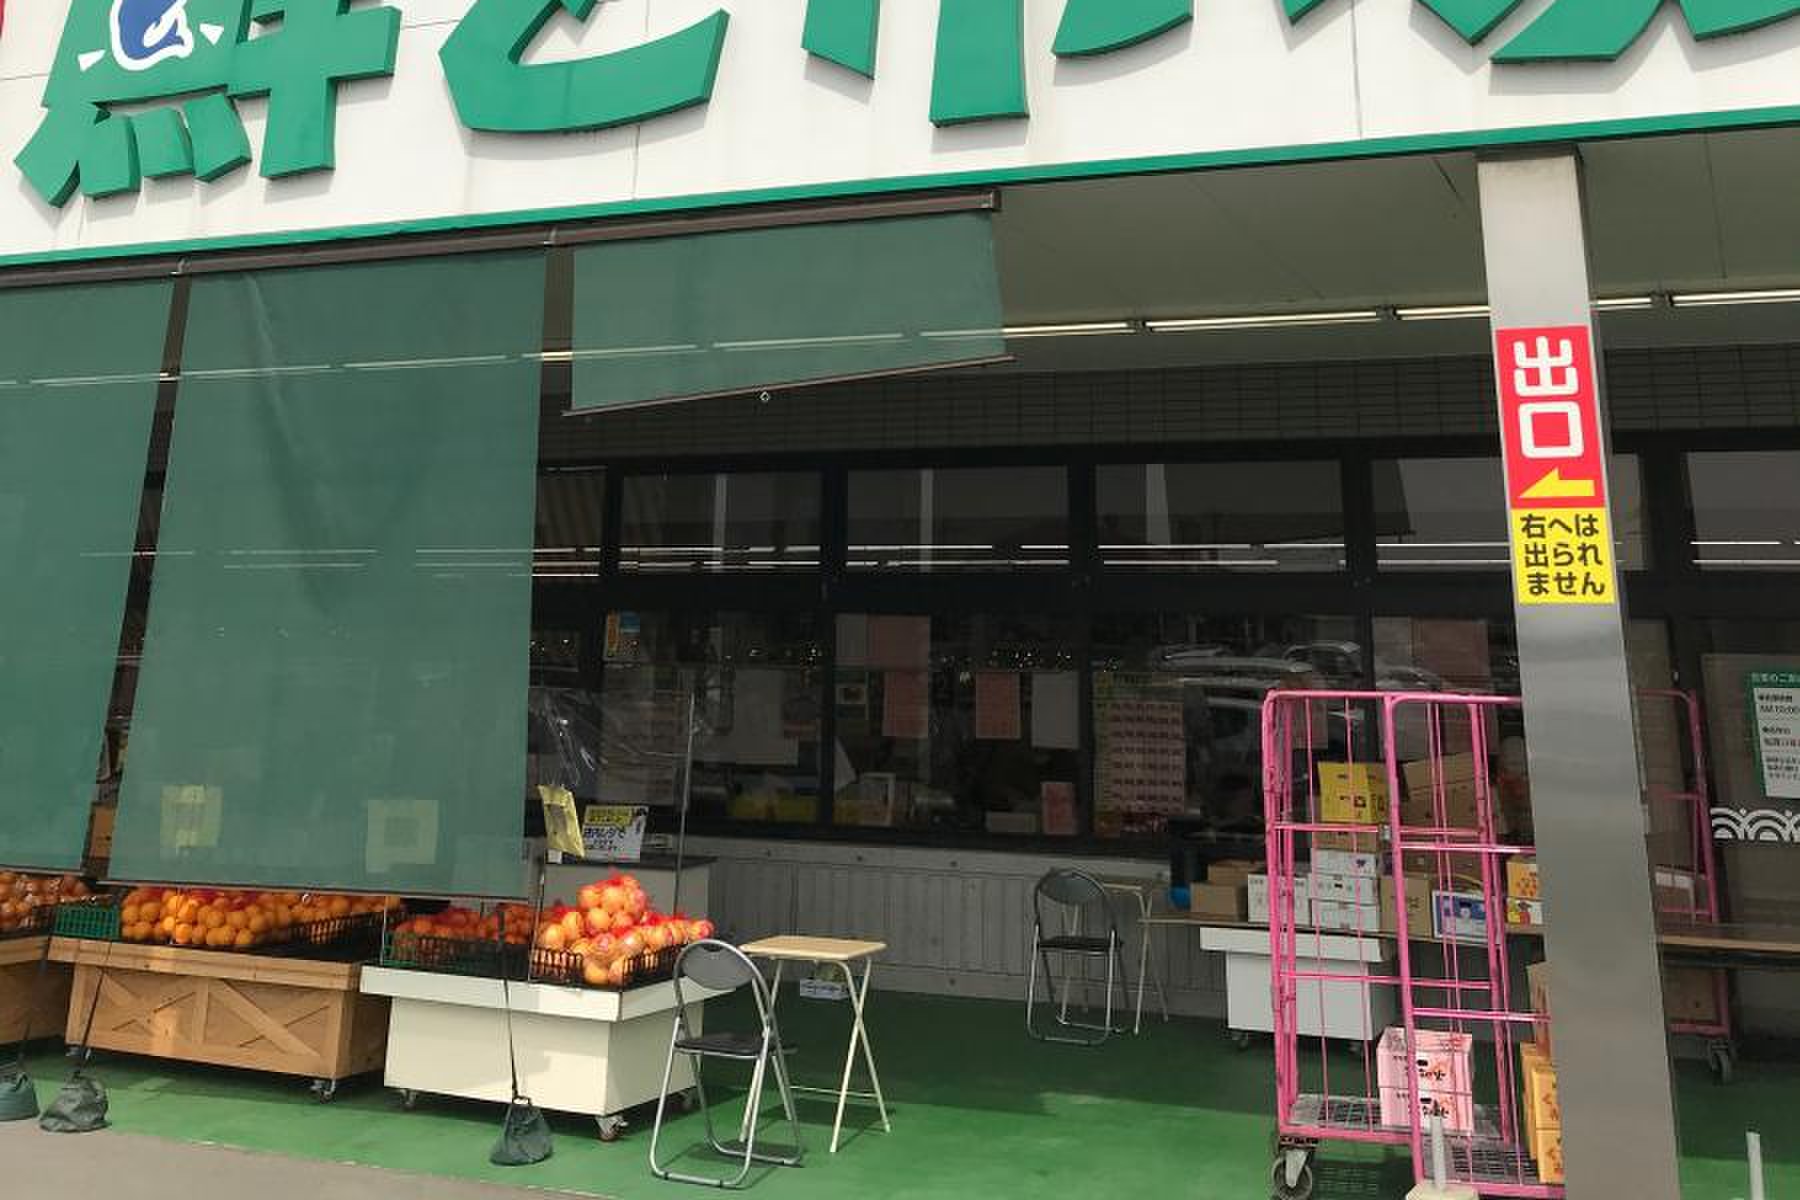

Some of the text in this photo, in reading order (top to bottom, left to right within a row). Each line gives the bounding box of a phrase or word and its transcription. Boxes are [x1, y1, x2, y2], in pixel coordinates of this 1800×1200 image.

[1513, 335, 1584, 458] 出口
[1520, 514, 1599, 539] 右へは
[1524, 543, 1603, 568] 出られ
[1527, 572, 1605, 596] ません
